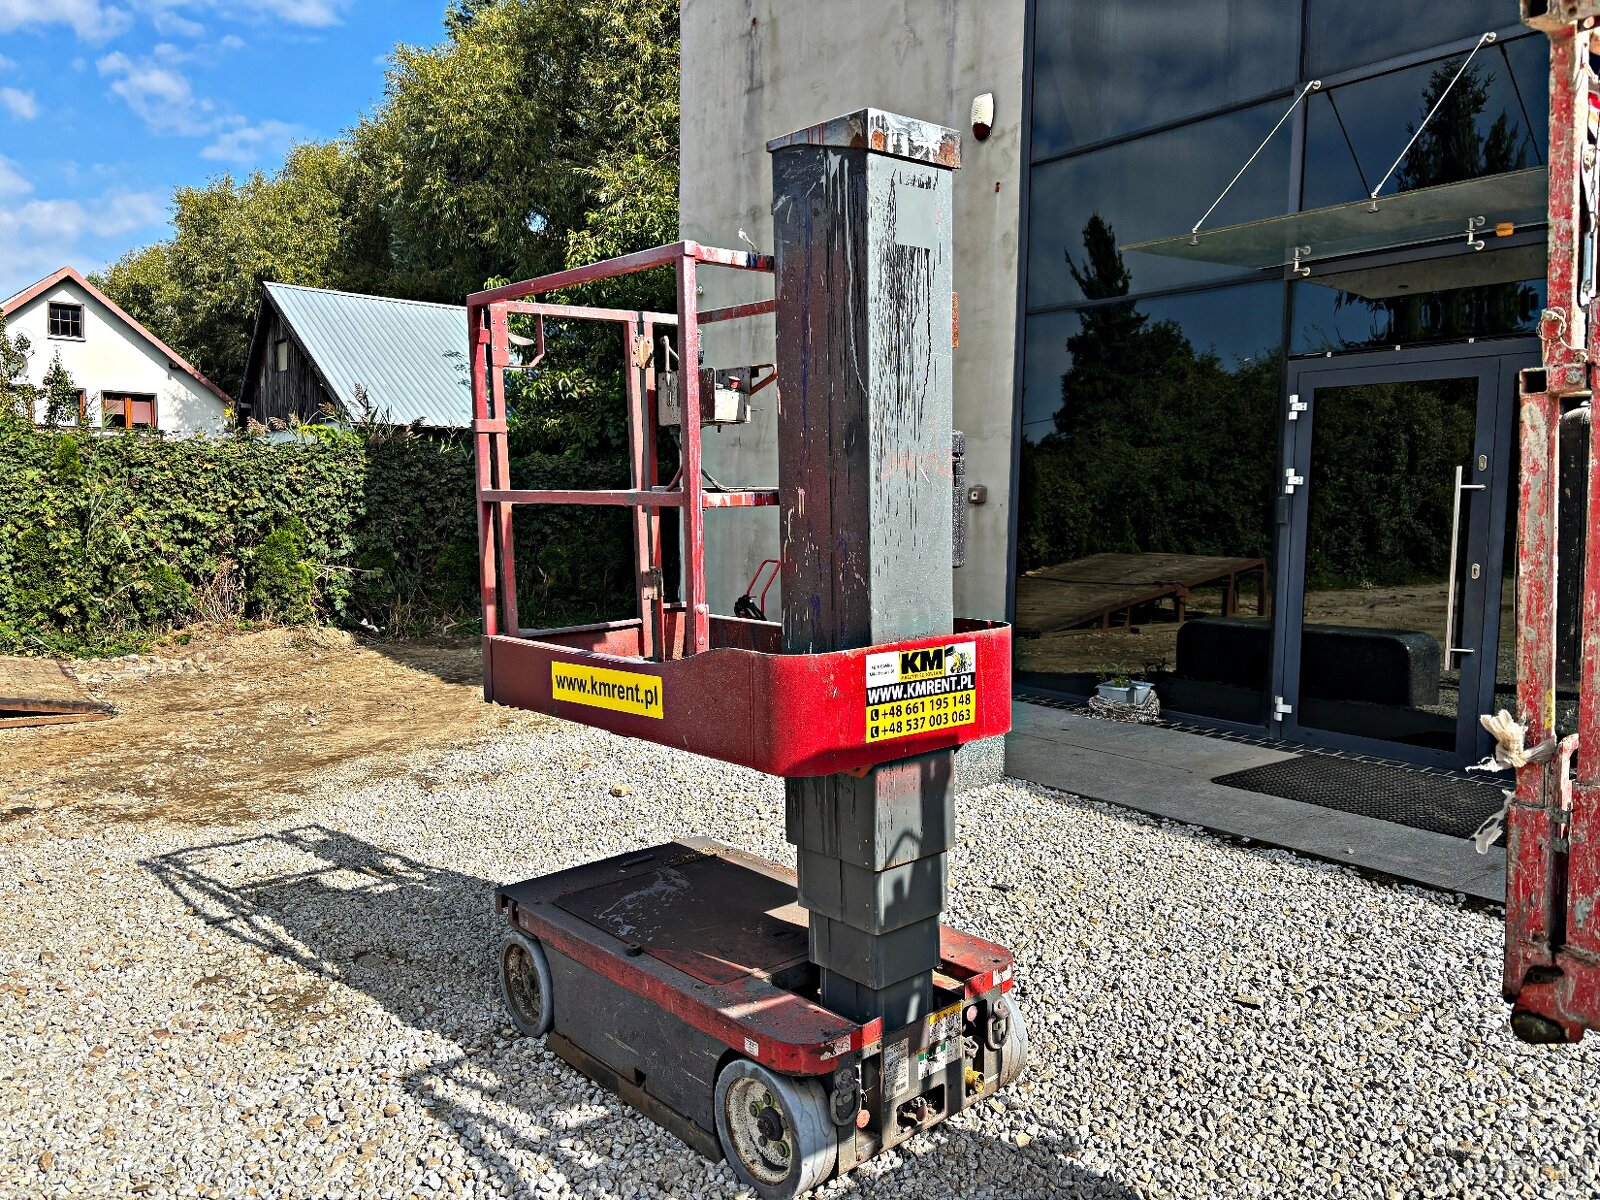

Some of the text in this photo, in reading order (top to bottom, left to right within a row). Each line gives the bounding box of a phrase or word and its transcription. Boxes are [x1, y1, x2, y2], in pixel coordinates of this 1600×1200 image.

[901, 648, 943, 674] KM
[555, 674, 658, 709] www.kmrent.pl
[868, 675, 974, 704] WWW.KMRENT.PL
[881, 693, 971, 720] +48 661 195 148
[881, 708, 971, 736] +48 537 003 063
